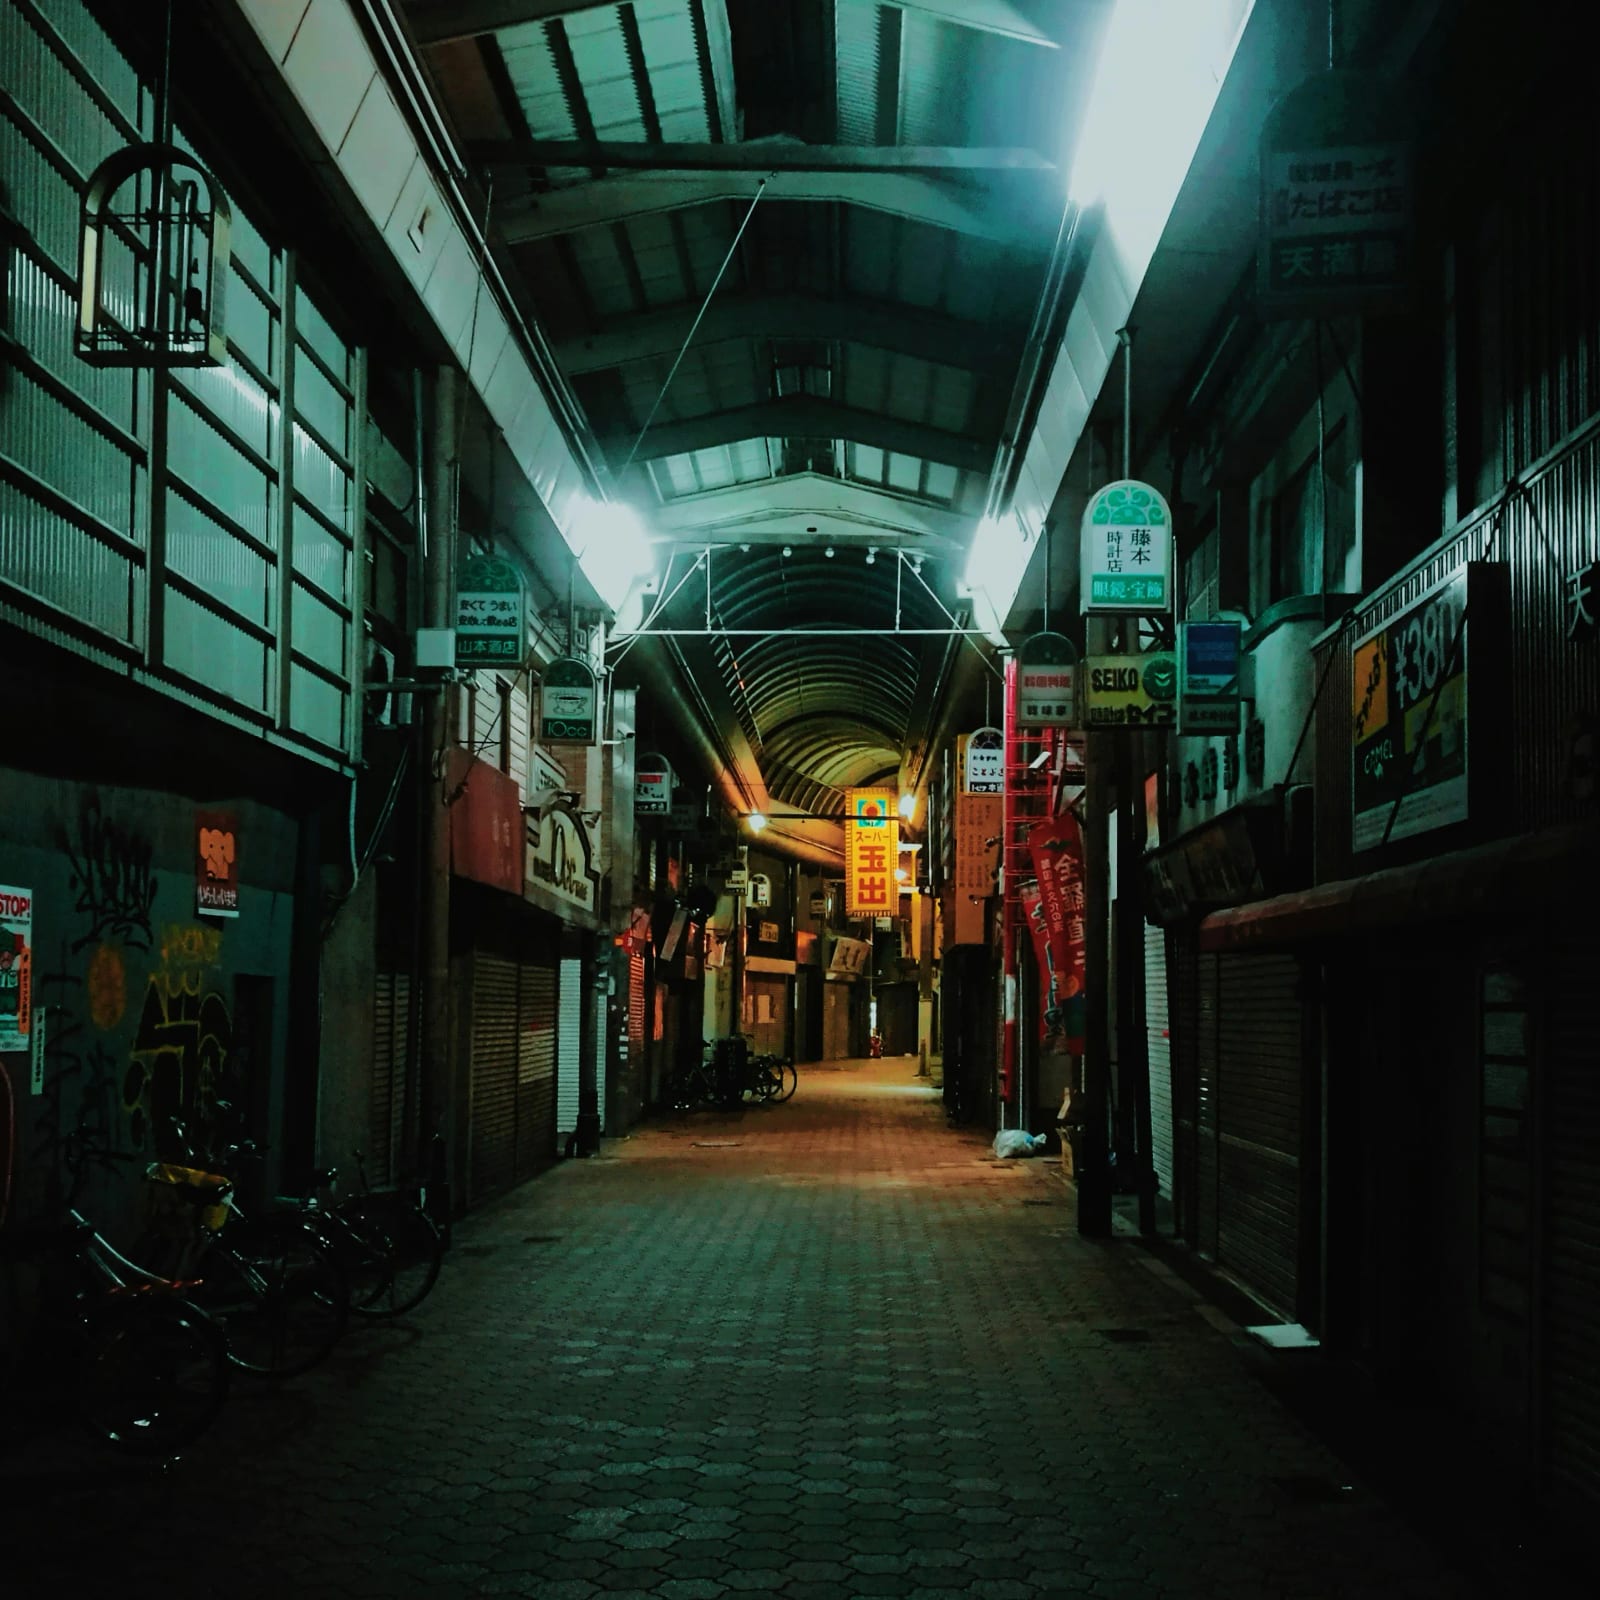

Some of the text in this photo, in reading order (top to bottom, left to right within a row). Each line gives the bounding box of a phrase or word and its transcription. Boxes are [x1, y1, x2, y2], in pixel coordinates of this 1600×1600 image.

[1107, 531, 1123, 573] 時計店
[1131, 528, 1151, 565] 藤本
[1091, 667, 1139, 693] SEIKO
[548, 720, 587, 737] 10cc
[1363, 737, 1394, 774] CAMEL
[857, 846, 887, 904] 玉出
